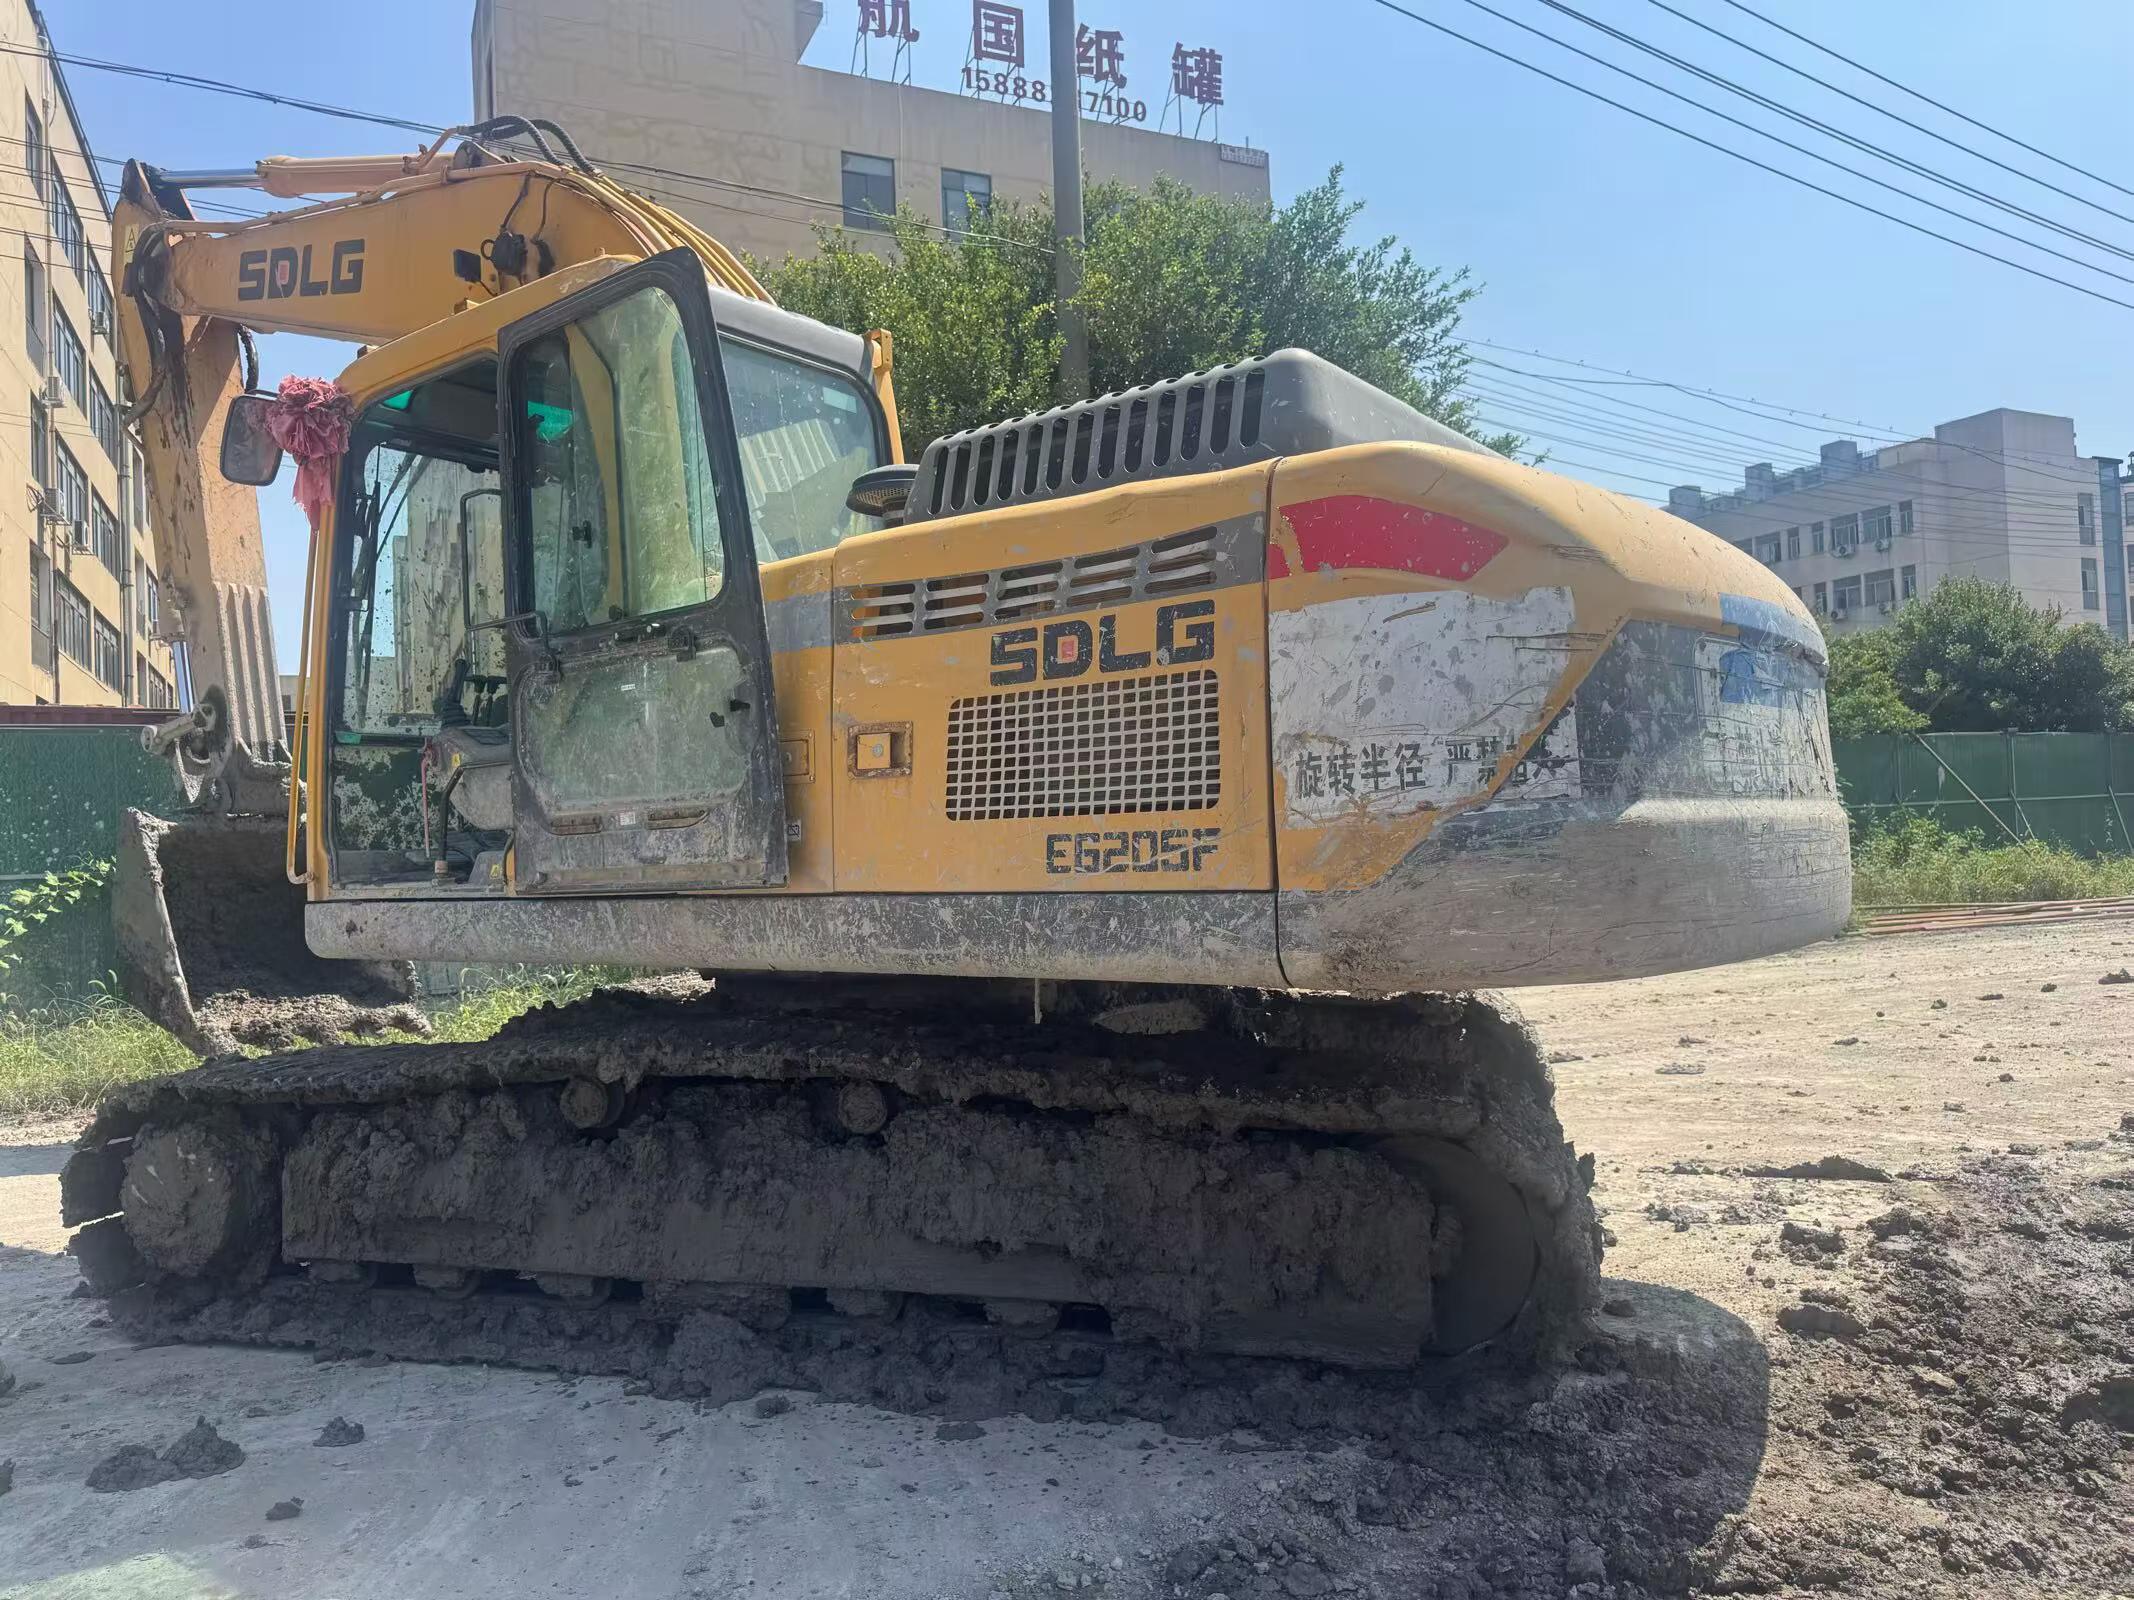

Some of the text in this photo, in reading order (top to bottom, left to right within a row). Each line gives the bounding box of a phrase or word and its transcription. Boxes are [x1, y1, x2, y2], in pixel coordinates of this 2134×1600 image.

[962, 67, 1146, 121] 158887100
[238, 238, 364, 300] SDLG
[990, 599, 1215, 686] SDLG
[1296, 743, 1426, 799] 旋转半径
[1046, 828, 1221, 874] E6205F
